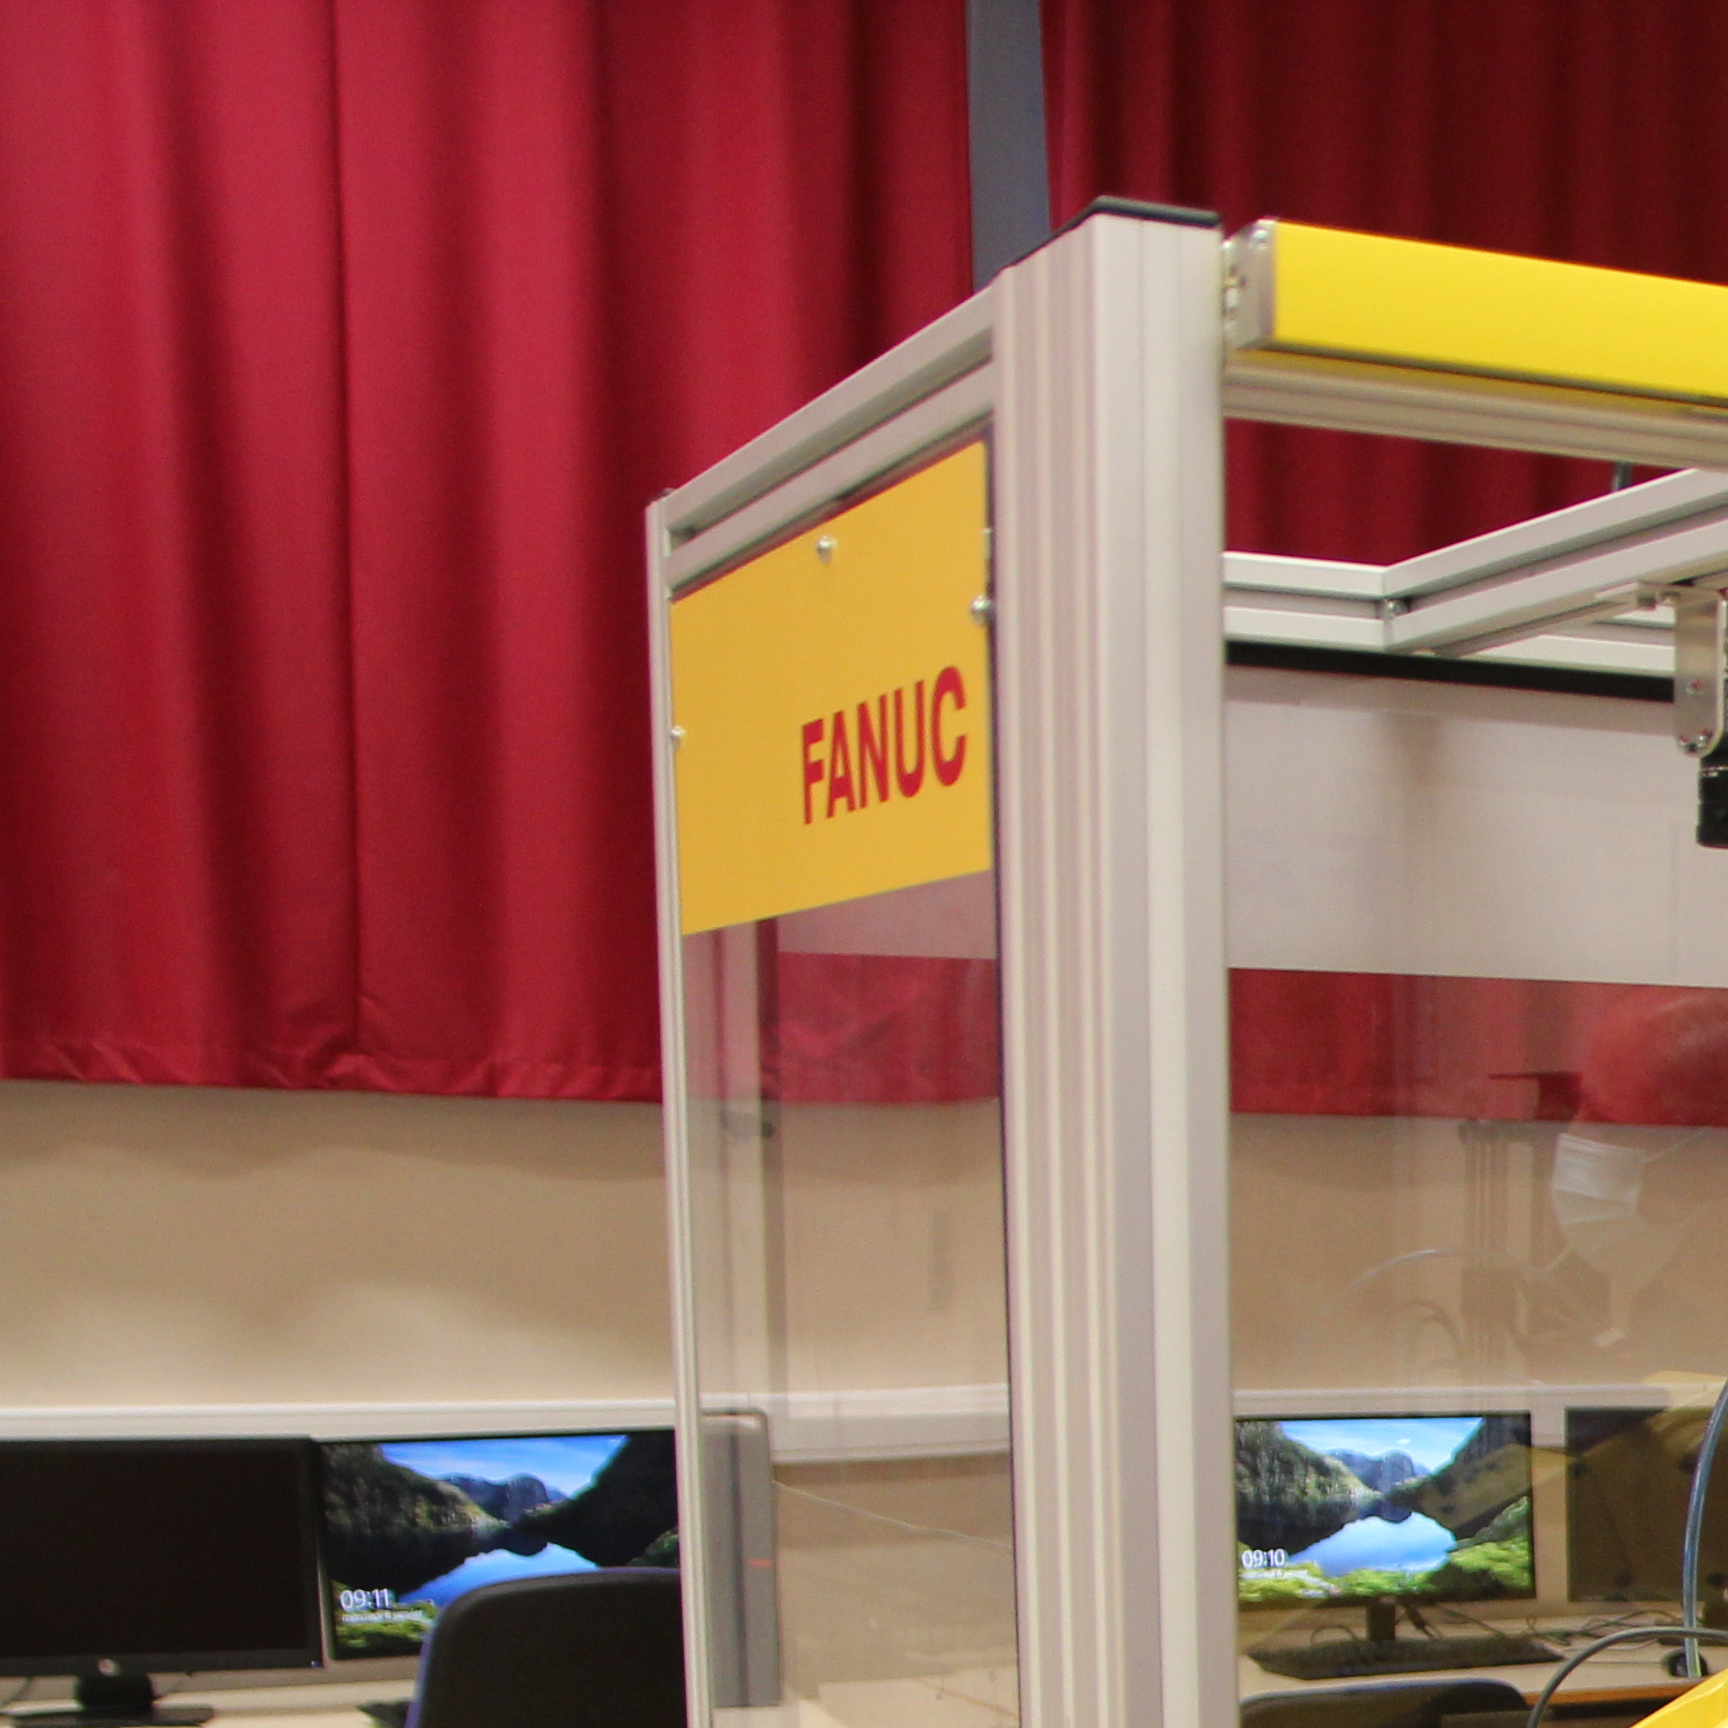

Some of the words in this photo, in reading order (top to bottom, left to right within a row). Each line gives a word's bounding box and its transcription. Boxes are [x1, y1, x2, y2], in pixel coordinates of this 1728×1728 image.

[801, 664, 967, 826] FANUC
[1242, 1549, 1286, 1569] 09:10
[340, 1588, 389, 1612] 09:11
